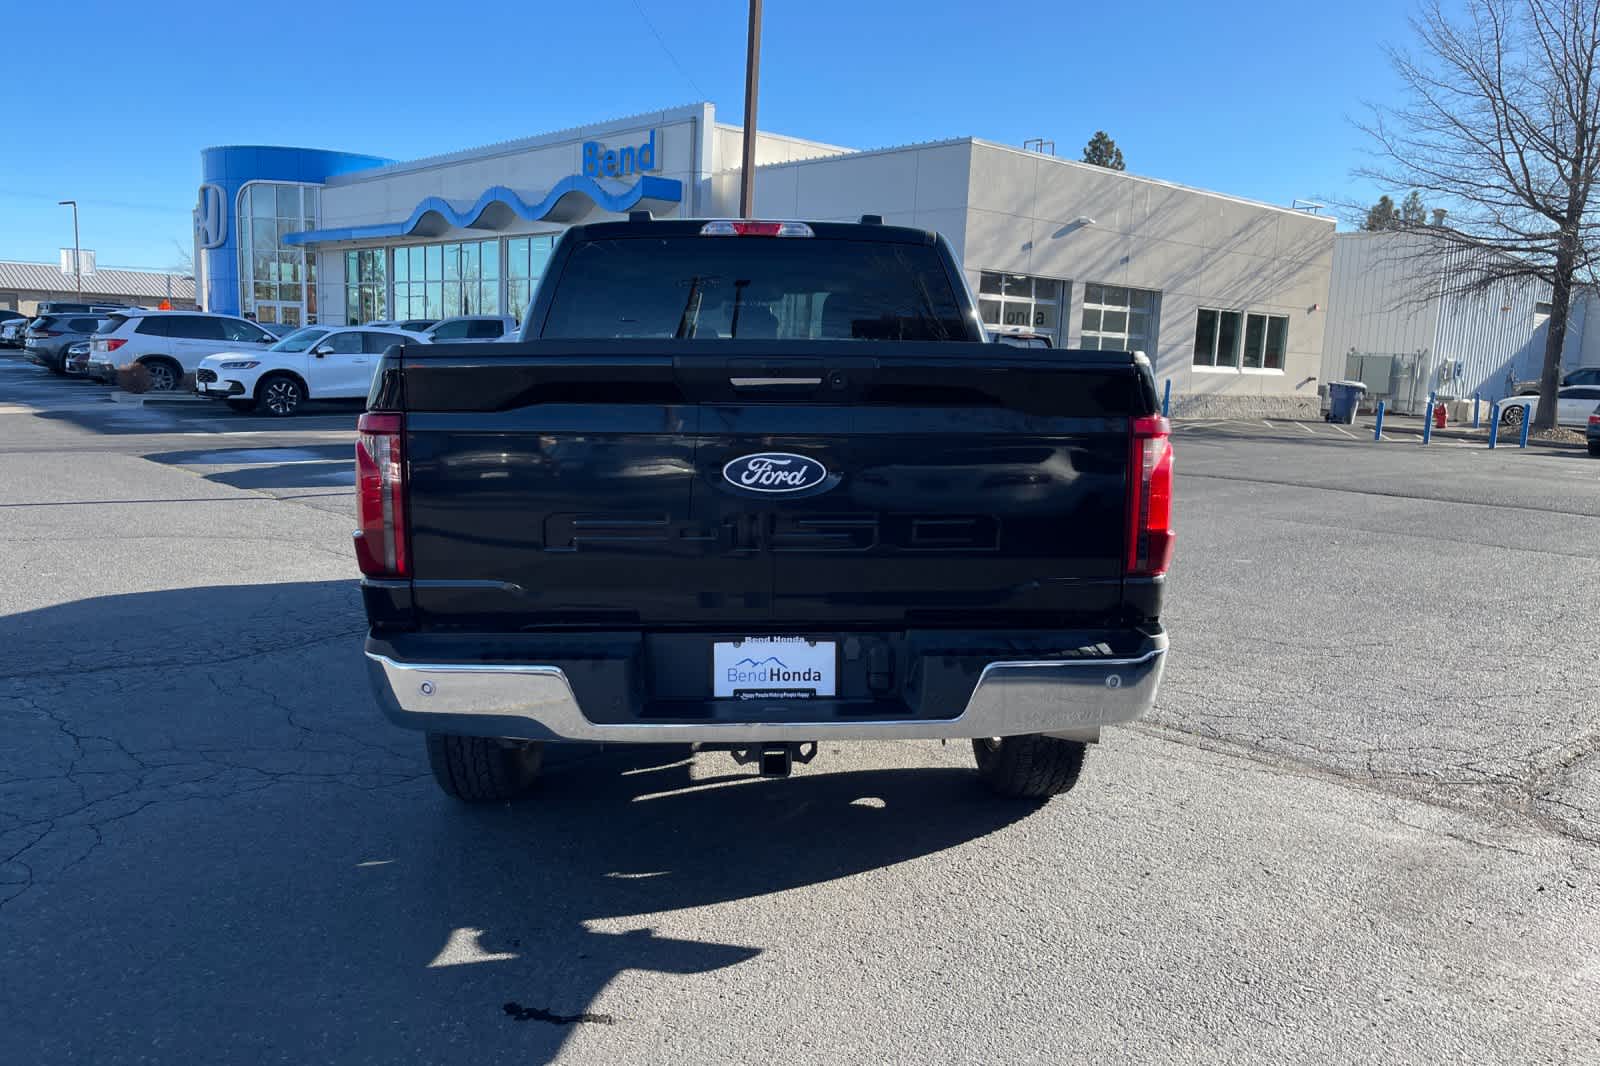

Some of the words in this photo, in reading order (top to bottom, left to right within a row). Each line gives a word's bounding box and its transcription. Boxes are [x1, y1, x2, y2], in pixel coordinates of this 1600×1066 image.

[582, 127, 656, 177] Bend
[741, 457, 808, 485] Ford
[744, 636, 771, 644] Bend
[773, 636, 806, 644] Honda
